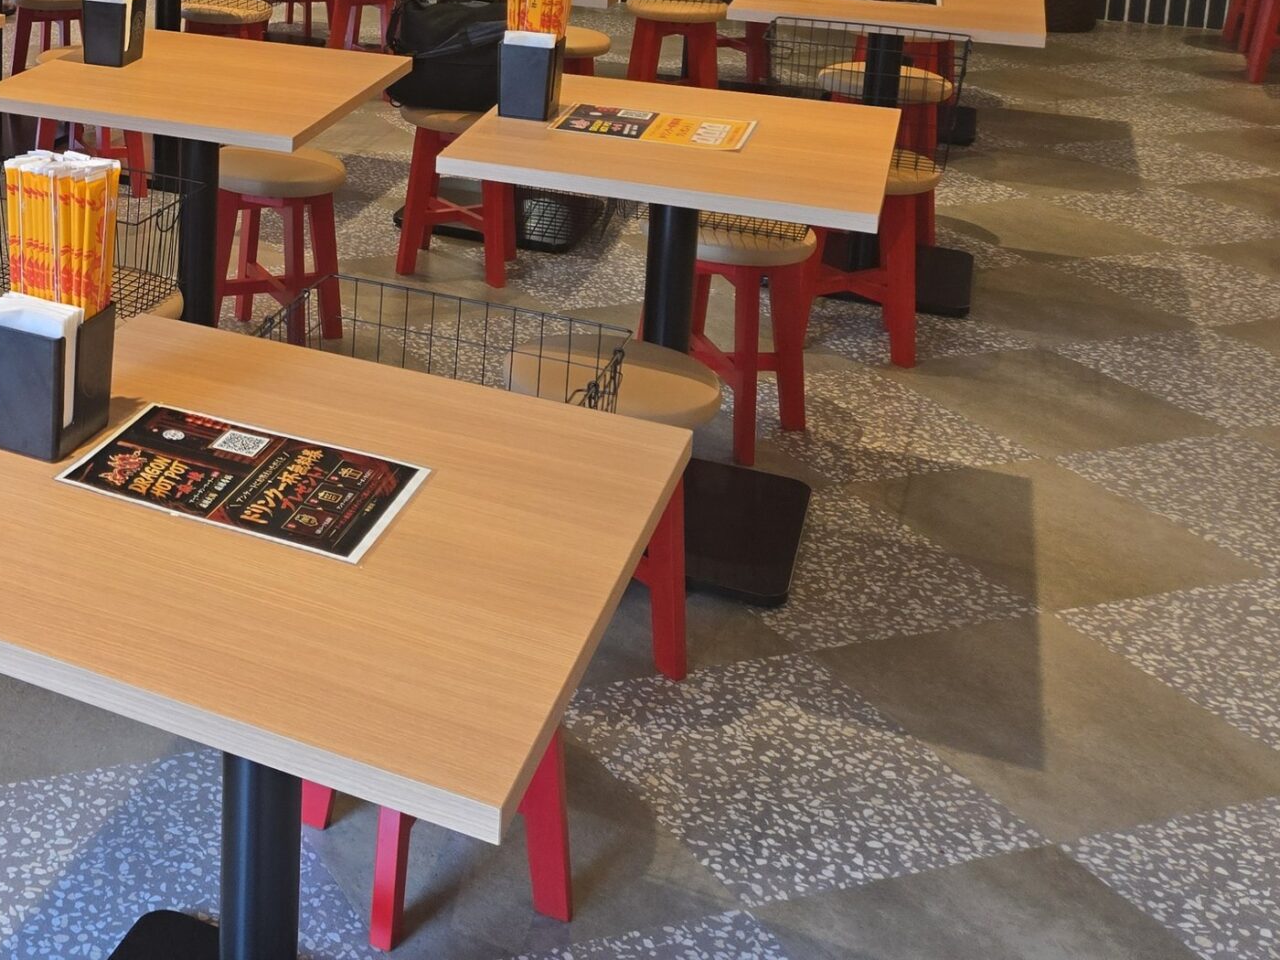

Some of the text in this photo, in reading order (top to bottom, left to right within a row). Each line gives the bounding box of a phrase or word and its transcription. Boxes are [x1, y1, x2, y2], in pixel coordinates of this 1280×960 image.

[128, 455, 172, 496] DRAGON
[150, 476, 177, 499] HOT
[164, 460, 191, 481] POT
